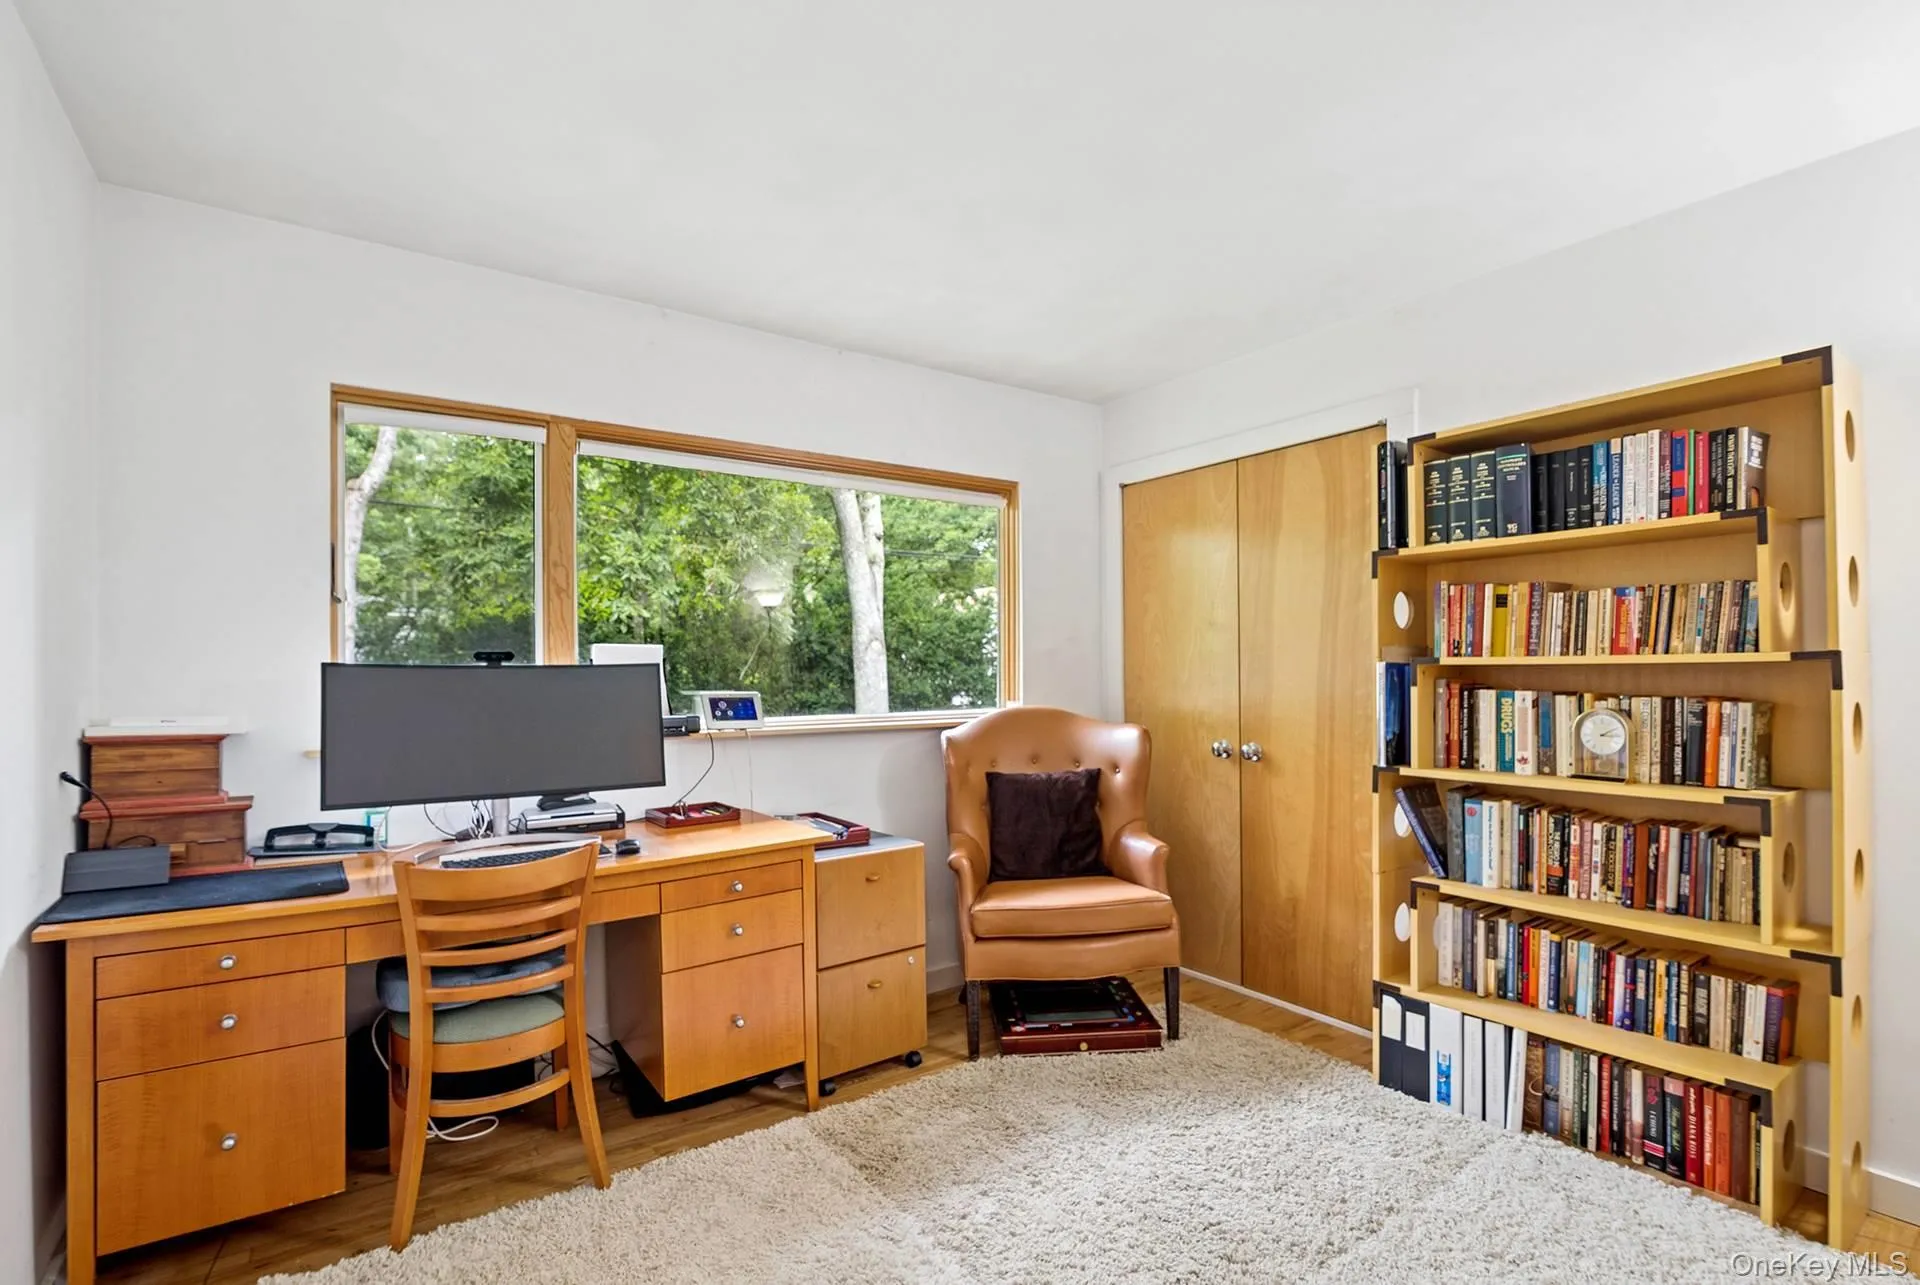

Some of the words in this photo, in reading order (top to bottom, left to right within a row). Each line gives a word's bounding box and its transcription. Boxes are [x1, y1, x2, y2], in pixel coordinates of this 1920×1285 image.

[1612, 454, 1621, 479] LEADER
[1612, 483, 1621, 507] LEADER
[1500, 697, 1513, 734] DRUGS
[1688, 1115, 1697, 1139] DIANA
